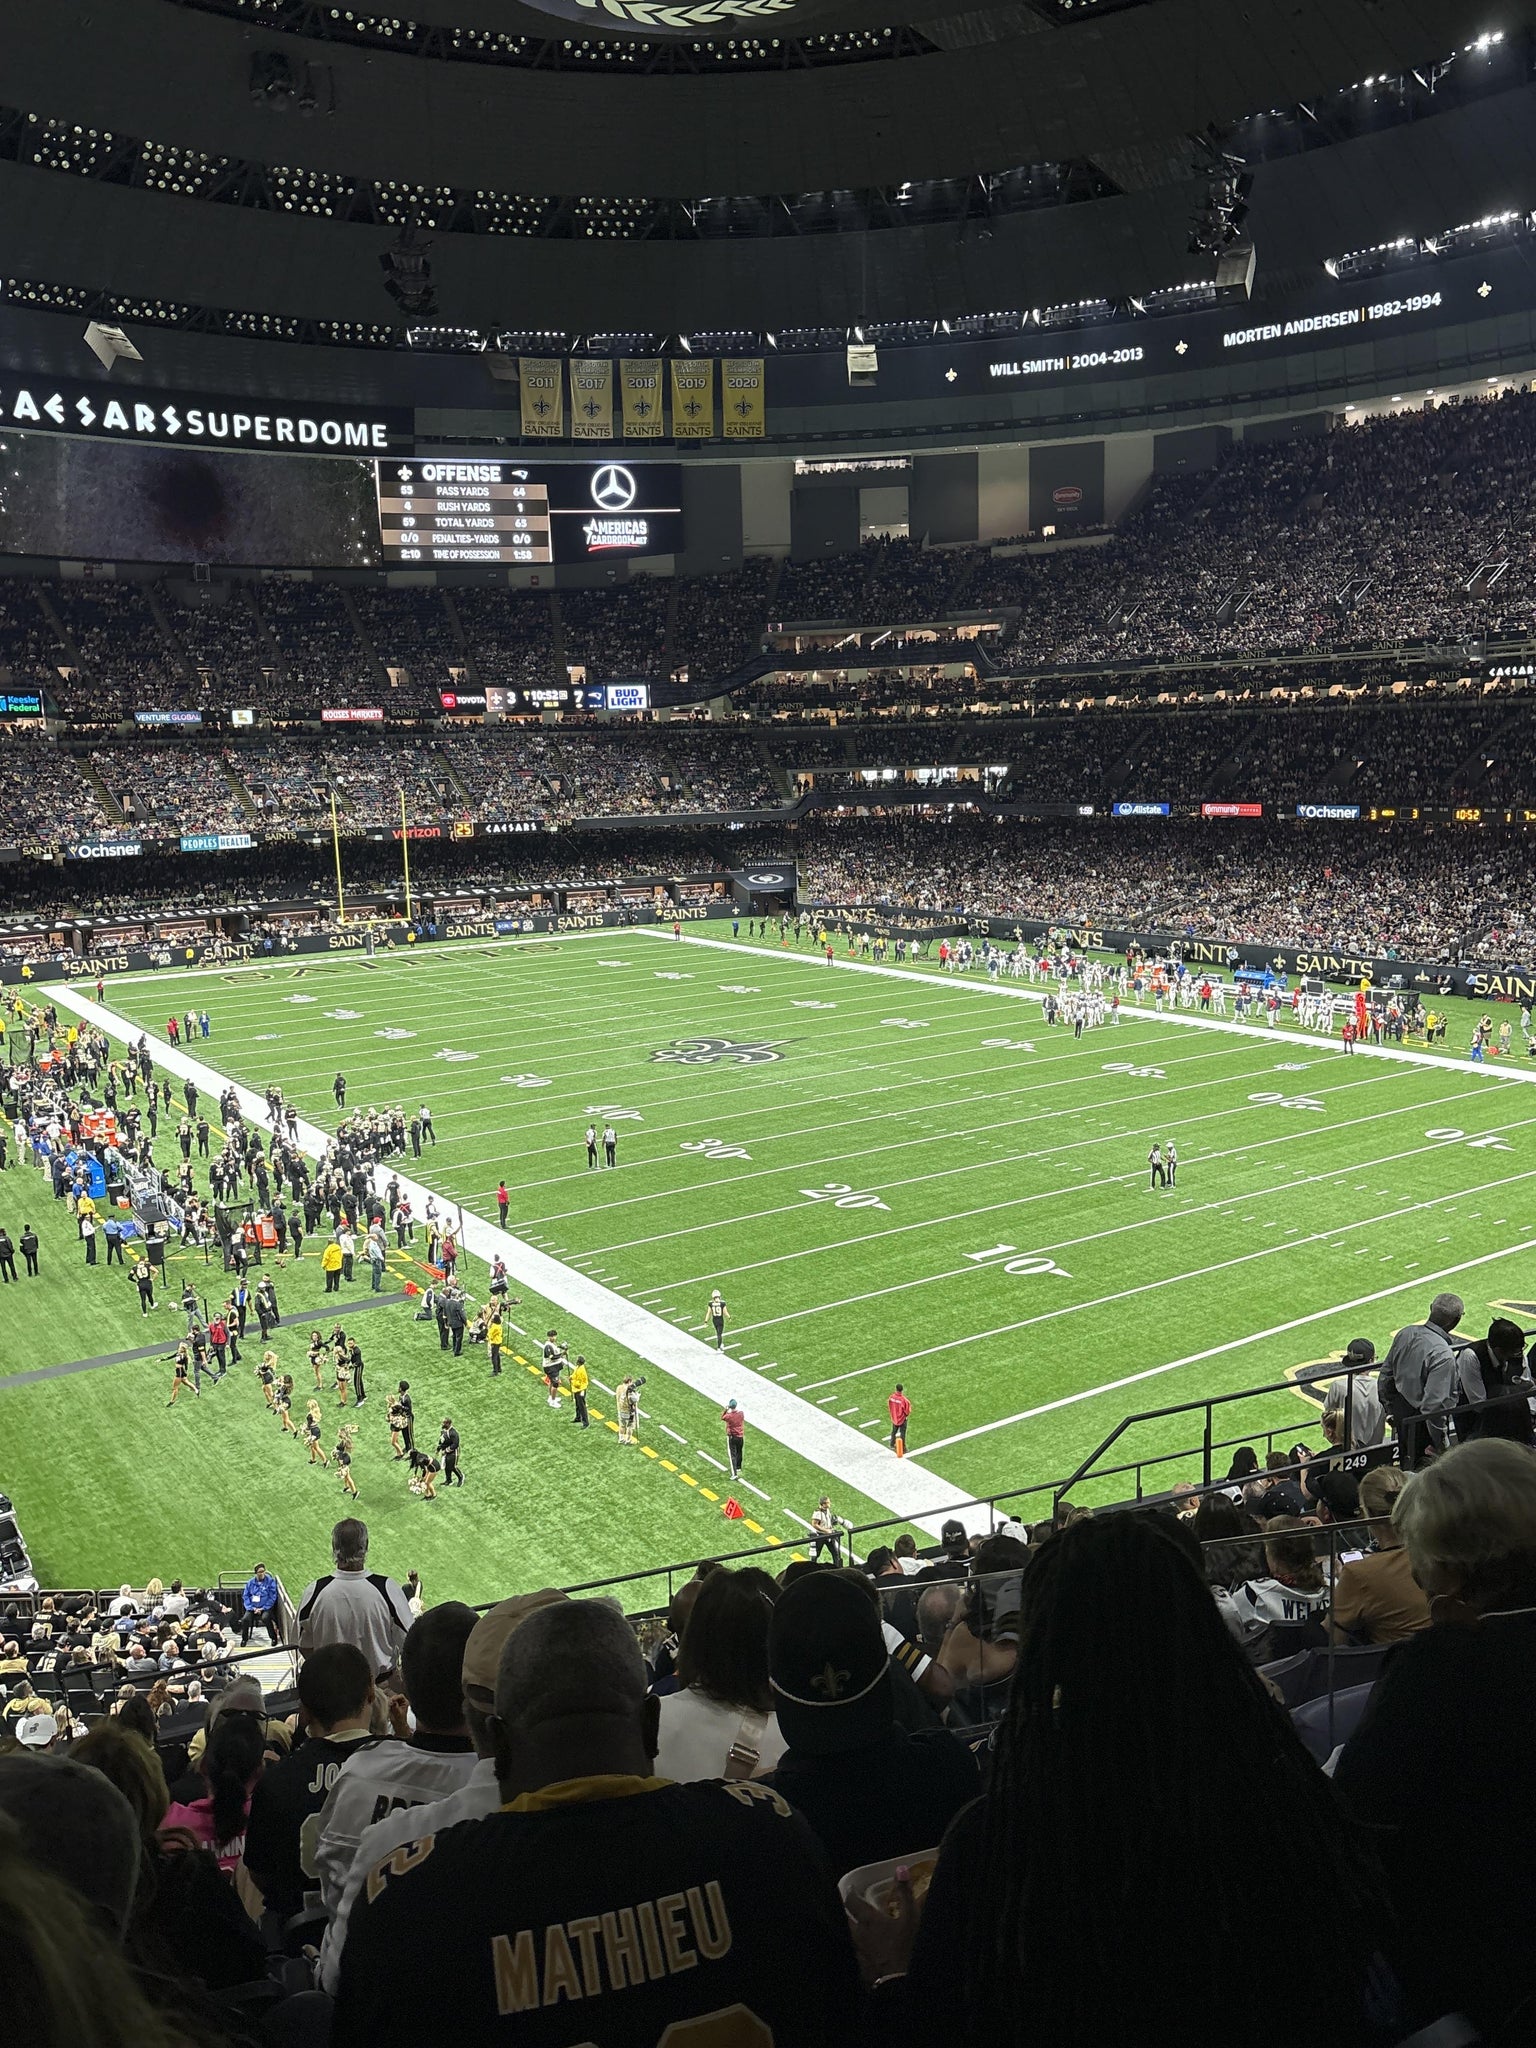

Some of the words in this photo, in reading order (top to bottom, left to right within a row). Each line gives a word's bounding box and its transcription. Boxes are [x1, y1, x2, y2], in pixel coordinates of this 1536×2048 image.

[1223, 323, 1281, 348] MORTEN
[1283, 308, 1359, 337] ANDERSEN
[1367, 291, 1442, 321] 1982-1994
[989, 362, 1021, 377] WILL
[1022, 357, 1065, 375] SMITH
[1071, 347, 1144, 369] 2004-2013
[528, 376, 554, 389] 2011
[578, 378, 606, 390] 2017
[628, 377, 657, 389] 2018
[678, 378, 706, 389] 2019
[728, 377, 758, 389] 2020
[0, 390, 182, 436] AESARS
[186, 410, 389, 448] SUPERDOME
[525, 425, 560, 436] SAINTS
[574, 427, 611, 438] SAINTS
[625, 426, 661, 436] SAINTS
[675, 426, 711, 437] SAINTS
[725, 426, 762, 436] SAINTS
[422, 464, 502, 482] OFFENSE
[436, 486, 459, 496] PASS
[459, 486, 490, 497] YARDS
[437, 502, 461, 512] RUSH
[461, 502, 491, 512] YARDS
[517, 502, 523, 512] 1
[435, 518, 464, 528] TOTAL
[465, 518, 494, 528] YARDS
[588, 517, 648, 535] AMERICAS
[400, 532, 419, 543] 0/0
[432, 533, 500, 544] PENALTIES-YARDS
[512, 534, 531, 545] 0/0
[433, 549, 450, 559] TIME
[450, 549, 459, 559] OF
[459, 549, 500, 560] POSSESSION
[1302, 646, 1333, 655] SAINTS
[1372, 640, 1405, 650] SAINTS
[1173, 654, 1202, 663] SAINTS
[1237, 650, 1266, 659] SAINTS
[1430, 669, 1462, 679] SAINTS
[1489, 665, 1536, 677] CAESAR
[1361, 674, 1392, 683] SAINTS
[507, 691, 516, 704] 3
[615, 688, 639, 697] BUD
[8, 695, 40, 704] Keesler
[457, 696, 486, 704] TOYOTA
[610, 697, 644, 706] LIGHT
[8, 703, 40, 712] Federal
[91, 711, 124, 720] SAINTS
[136, 713, 170, 721] VENTURE
[171, 713, 201, 721] GLOBAL
[260, 710, 290, 718] SAINTS
[323, 710, 350, 719] ROUSES
[350, 710, 383, 719] MARKETS
[1132, 805, 1162, 814] Allstate
[1173, 804, 1200, 813] SAINTS
[1204, 804, 1240, 815] Community
[1306, 805, 1358, 819] Ochsner
[1455, 809, 1480, 820] 10:52
[485, 822, 537, 833] CAESARS
[544, 818, 573, 827] SAINTS
[335, 828, 367, 837] SAINTS
[393, 826, 441, 840] verizon
[456, 823, 471, 835] 25
[182, 836, 218, 849] PEOPLES
[219, 834, 250, 848] HEALTH
[264, 831, 297, 841] SAINTS
[22, 845, 60, 855] SAINTS
[78, 844, 141, 858] Ochsner
[385, 886, 501, 901] CAESARS
[503, 879, 626, 893] SUPERDOME
[114, 903, 263, 923] SUPERDOME
[663, 907, 708, 920] SAINTS
[557, 914, 603, 929] SAINTS
[446, 922, 495, 938] SAINTS
[329, 932, 381, 948] SAINS
[70, 955, 128, 975] SAINTS
[1248, 1092, 1325, 1109] 20
[582, 1104, 641, 1121] 40
[1425, 1128, 1508, 1148] 10
[679, 1138, 746, 1160] 30
[800, 1183, 882, 1209] 20
[962, 1243, 1057, 1275] 10
[712, 1306, 722, 1317] 19
[1345, 1454, 1368, 1472] 249
[491, 1880, 733, 2016] MATHIEU
